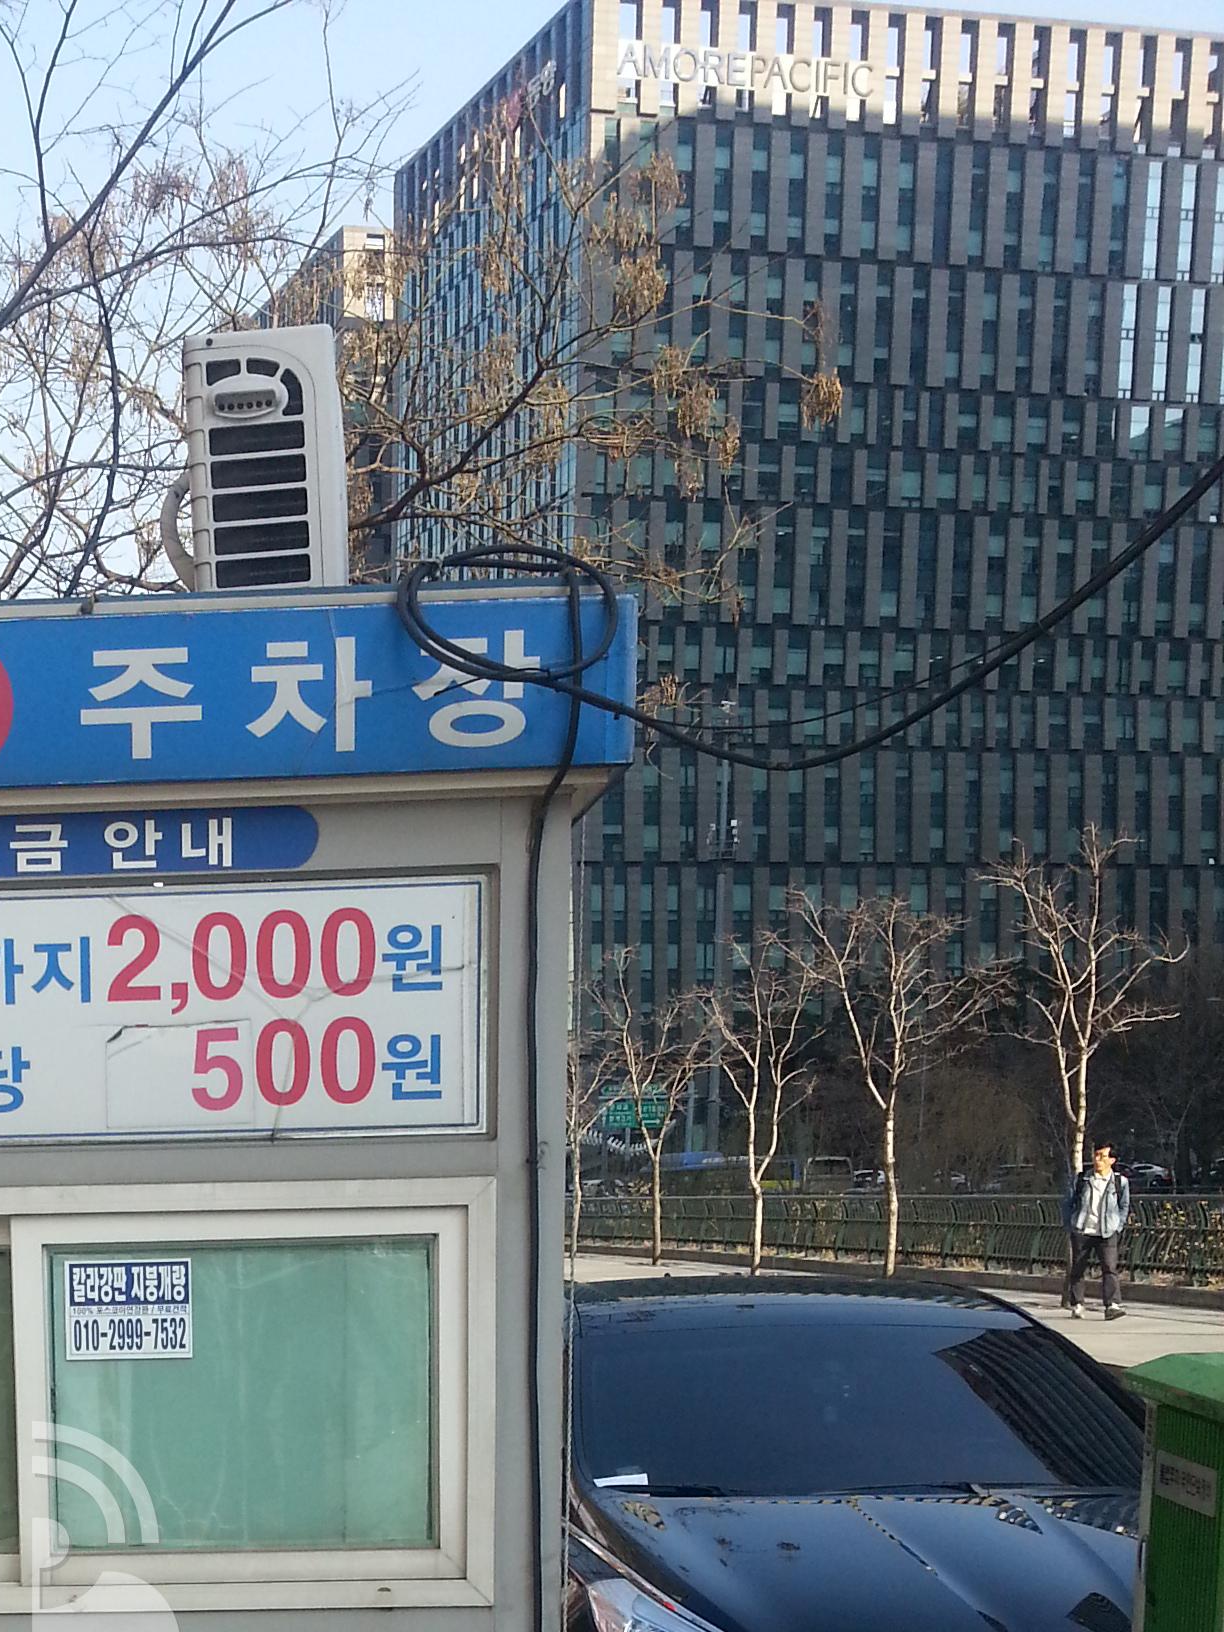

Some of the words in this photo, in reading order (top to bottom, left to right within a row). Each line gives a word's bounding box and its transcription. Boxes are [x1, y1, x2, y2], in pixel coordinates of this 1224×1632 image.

[617, 43, 874, 97] AMOREPACIFIC
[80, 629, 541, 760] 주차장
[107, 817, 236, 872] 안내
[191, 1015, 445, 1111] 500원
[131, 1265, 186, 1301] 지붕개량
[73, 1317, 186, 1351] 010-2999-7532
